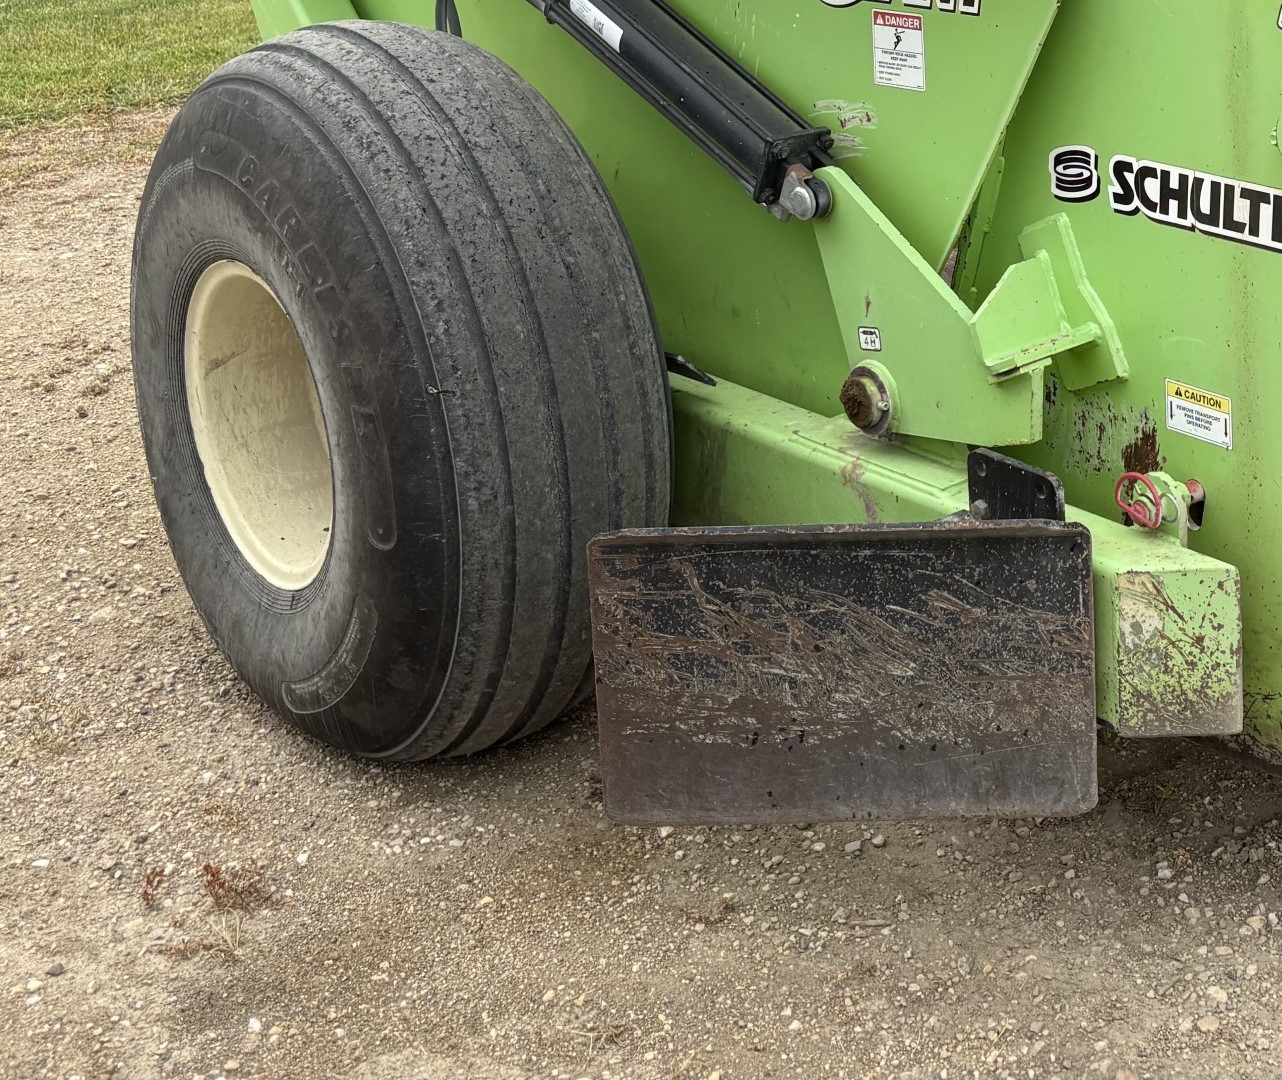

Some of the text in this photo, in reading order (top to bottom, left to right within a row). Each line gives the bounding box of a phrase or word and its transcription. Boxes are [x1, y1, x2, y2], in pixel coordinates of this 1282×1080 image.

[885, 15, 920, 29] DANGER
[1184, 389, 1222, 409] CAUTION
[1176, 404, 1194, 414] REMOVE
[1186, 419, 1212, 432] OPERATING
